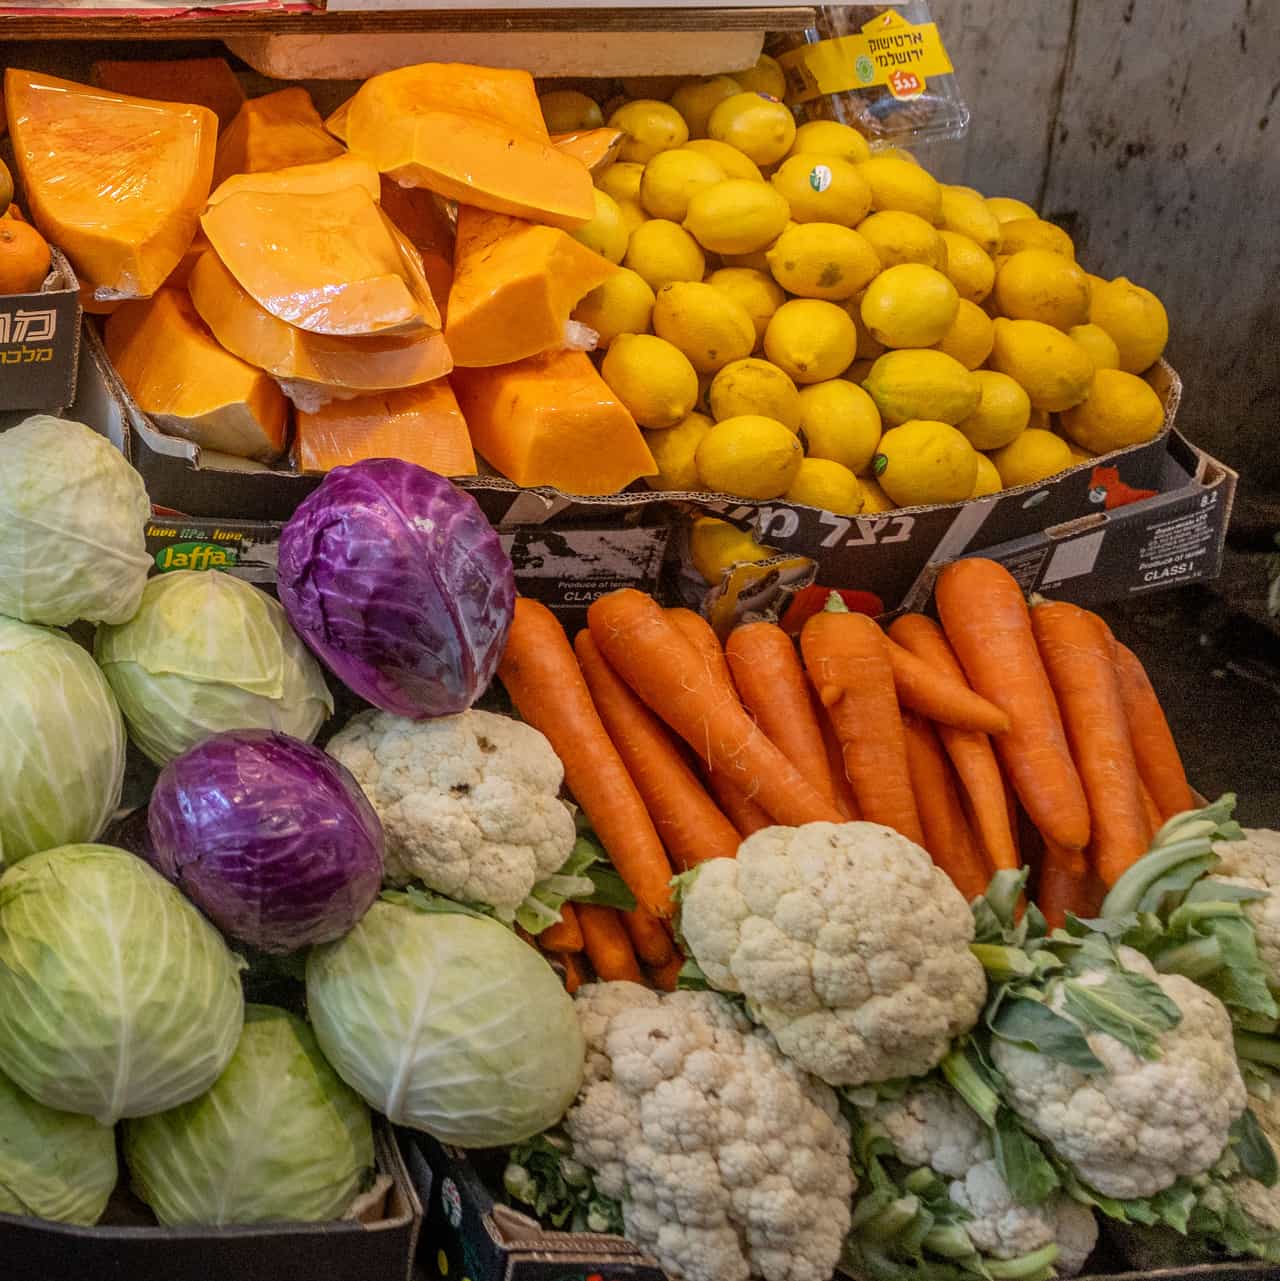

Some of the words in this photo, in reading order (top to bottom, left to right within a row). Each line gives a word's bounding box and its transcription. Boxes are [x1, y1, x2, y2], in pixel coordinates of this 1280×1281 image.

[868, 31, 923, 53] ארטישוק
[875, 48, 924, 68] ירושלמי
[146, 525, 177, 537] love
[818, 510, 916, 548] בצל
[164, 546, 227, 570] Jaffa
[1143, 563, 1183, 582] CLASS
[558, 581, 596, 589] Produce
